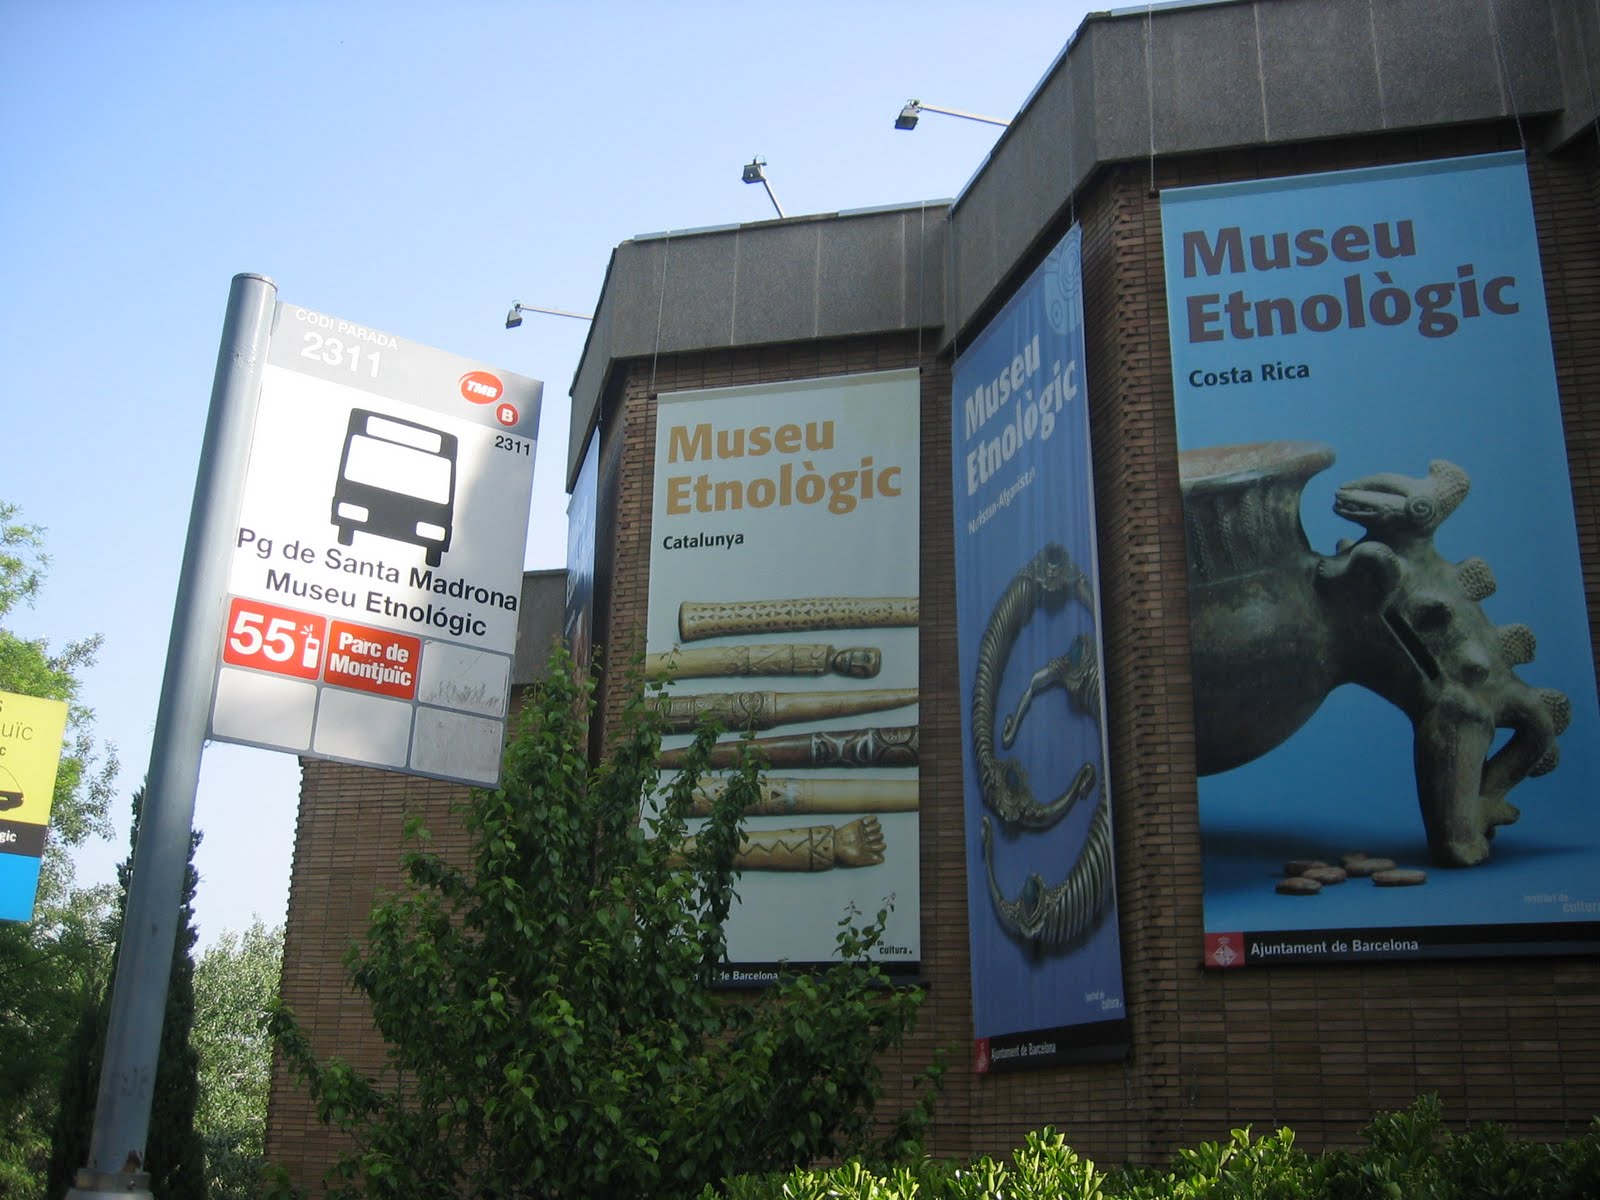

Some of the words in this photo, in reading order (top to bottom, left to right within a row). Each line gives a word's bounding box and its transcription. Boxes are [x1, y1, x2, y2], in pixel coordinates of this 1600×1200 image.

[1183, 219, 1416, 278] Museu
[1186, 263, 1520, 343] Etnològic
[295, 308, 337, 331] CODI
[338, 320, 399, 350] PARADA
[300, 331, 381, 378] 2311
[1188, 366, 1253, 388] Costa
[1261, 361, 1310, 381] Rica
[467, 380, 497, 398] TMB
[965, 333, 1041, 440] Museu
[501, 408, 514, 423] B
[966, 359, 1077, 497] Etnològic
[495, 435, 530, 456] 2311
[667, 420, 835, 464] Museu
[666, 456, 902, 515] Etnològic
[662, 533, 744, 550] Catalunya
[237, 527, 273, 559] Pg
[283, 538, 316, 564] de
[325, 548, 400, 583] Santa
[409, 567, 518, 611] Madrona
[266, 568, 356, 608] Museu
[366, 591, 487, 637] Etnológic
[229, 610, 296, 662] 55
[338, 631, 382, 659] Parc
[385, 642, 409, 663] de
[329, 653, 412, 687] Montjuïc
[1251, 941, 1327, 958] Ajuntament
[1331, 940, 1348, 952] de
[1352, 939, 1419, 951] Barcelona
[733, 970, 778, 980] Barcelona
[1029, 1041, 1057, 1056] Barcelona
